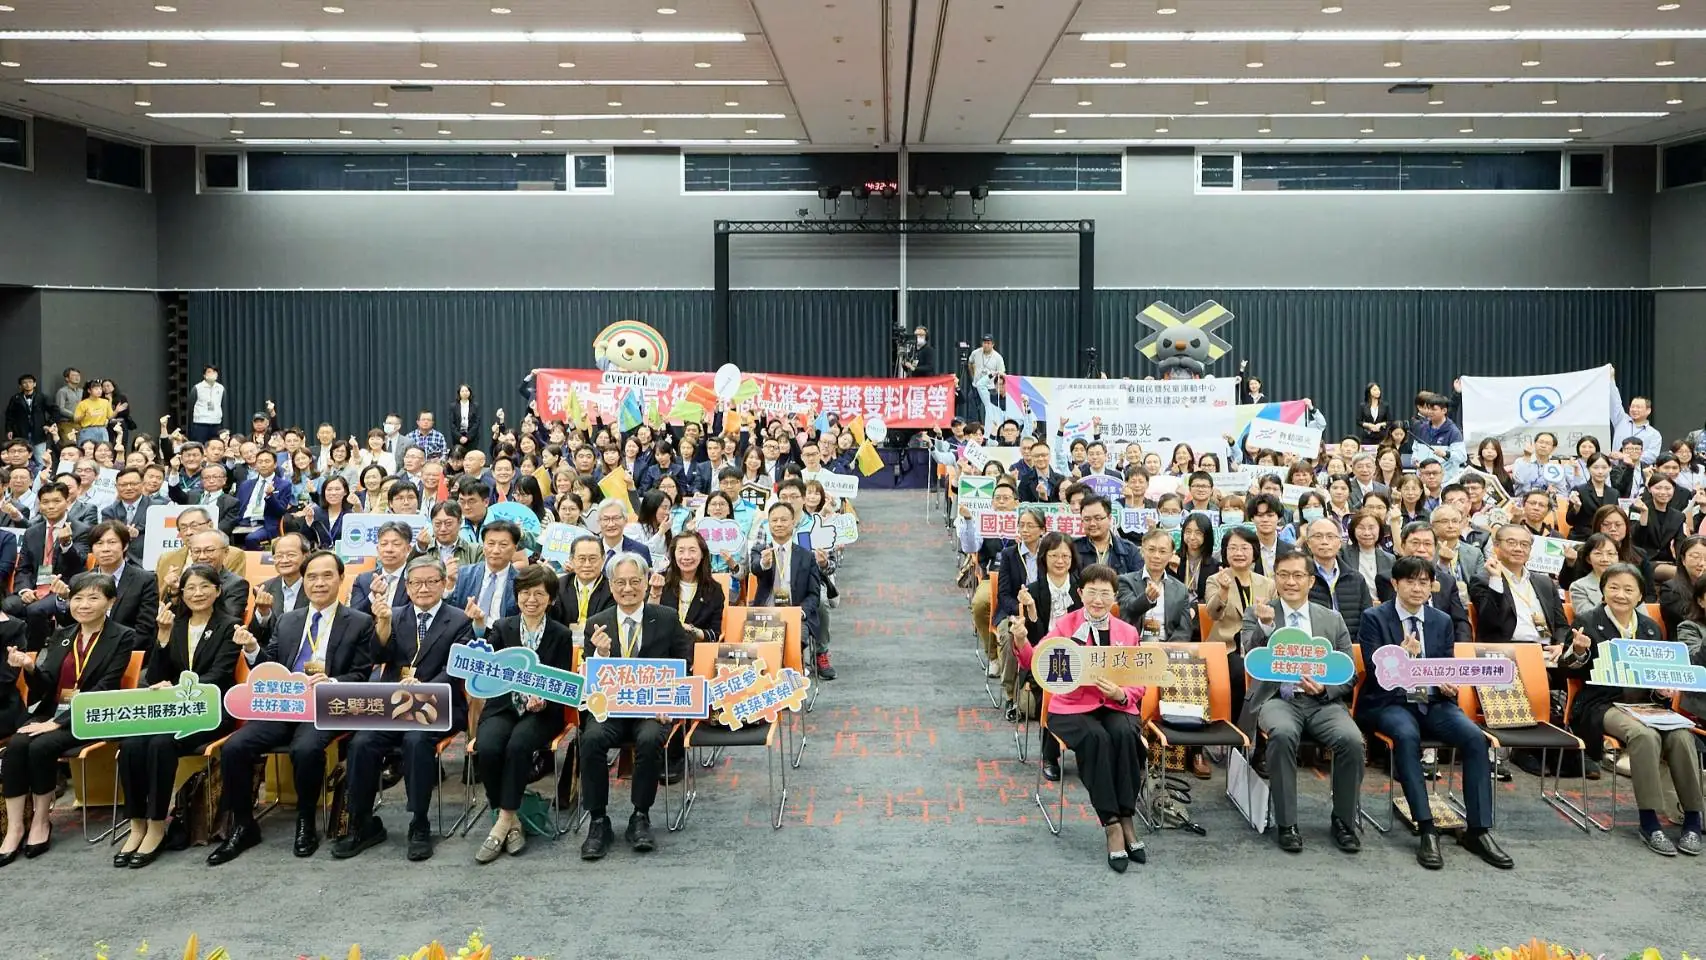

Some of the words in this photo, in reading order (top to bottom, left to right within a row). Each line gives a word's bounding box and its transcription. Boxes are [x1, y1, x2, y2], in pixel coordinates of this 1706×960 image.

[605, 374, 648, 386] everrich
[1090, 651, 1153, 670] 財政部
[1628, 646, 1676, 660] 公私協力
[454, 654, 579, 698] 加速社會經濟發展
[598, 667, 675, 686] 公私協力
[1411, 666, 1455, 677] 公私協力
[1459, 665, 1504, 677] 促參精神
[617, 685, 692, 706] 共創三贏
[734, 683, 793, 719] 共築繁榮
[86, 701, 207, 723] 提升公共服務水準
